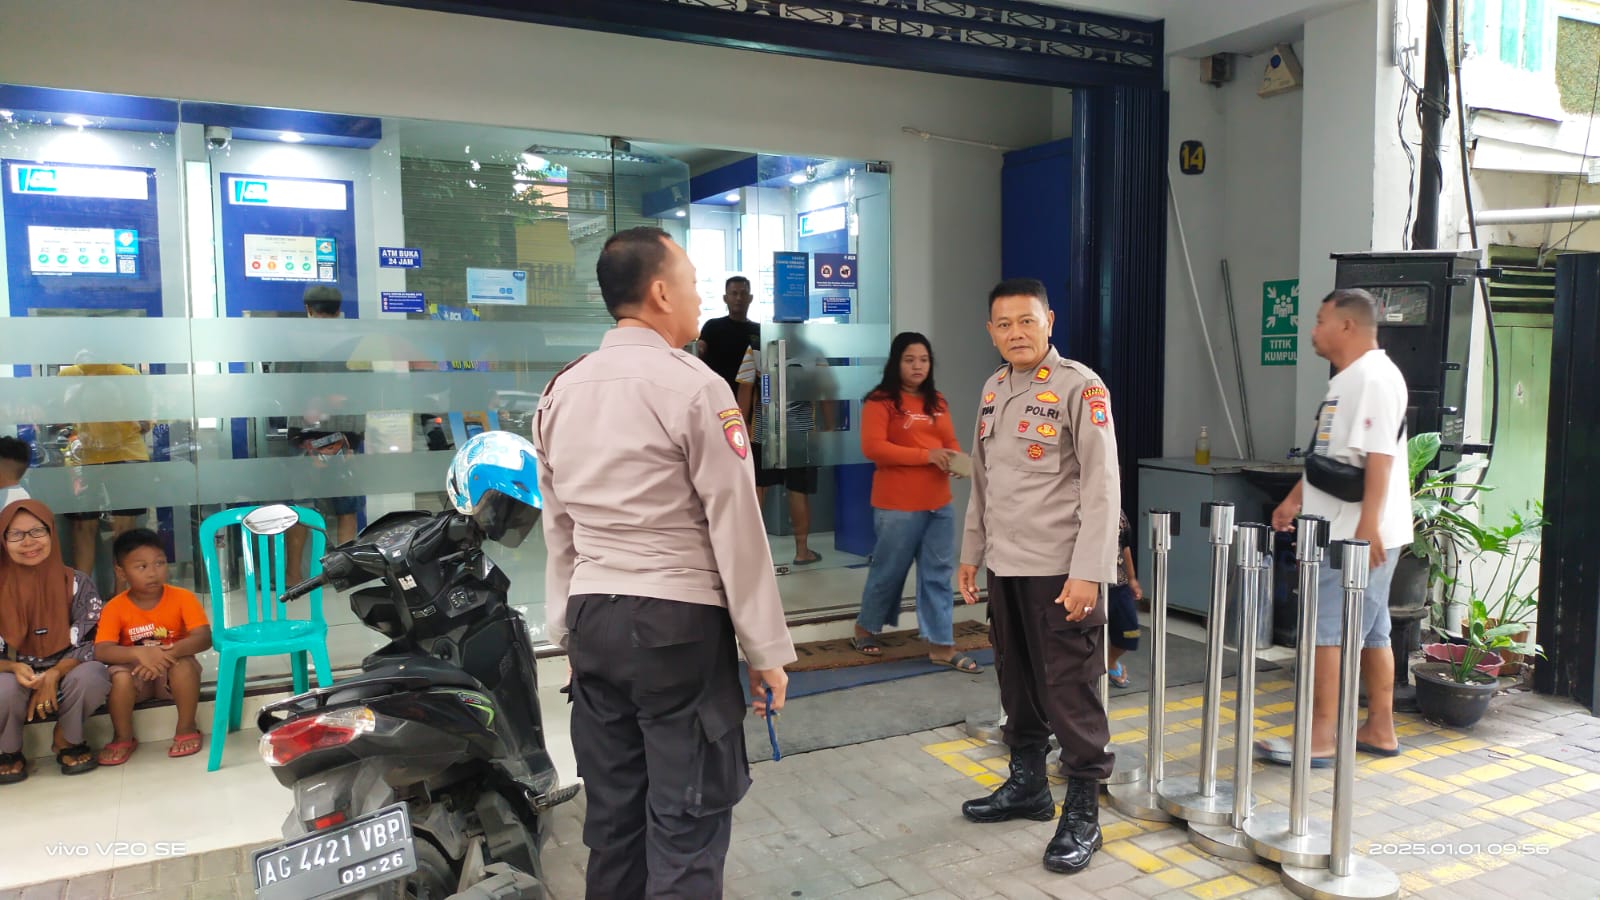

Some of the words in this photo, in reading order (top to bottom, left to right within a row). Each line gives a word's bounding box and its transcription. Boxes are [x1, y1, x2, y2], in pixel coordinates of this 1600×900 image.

[1182, 144, 1204, 171] 14
[1269, 339, 1292, 349] TITIK
[1024, 405, 1060, 420] POLRI
[264, 855, 292, 885] AG
[299, 835, 353, 871] 4421
[360, 818, 401, 851] VBP
